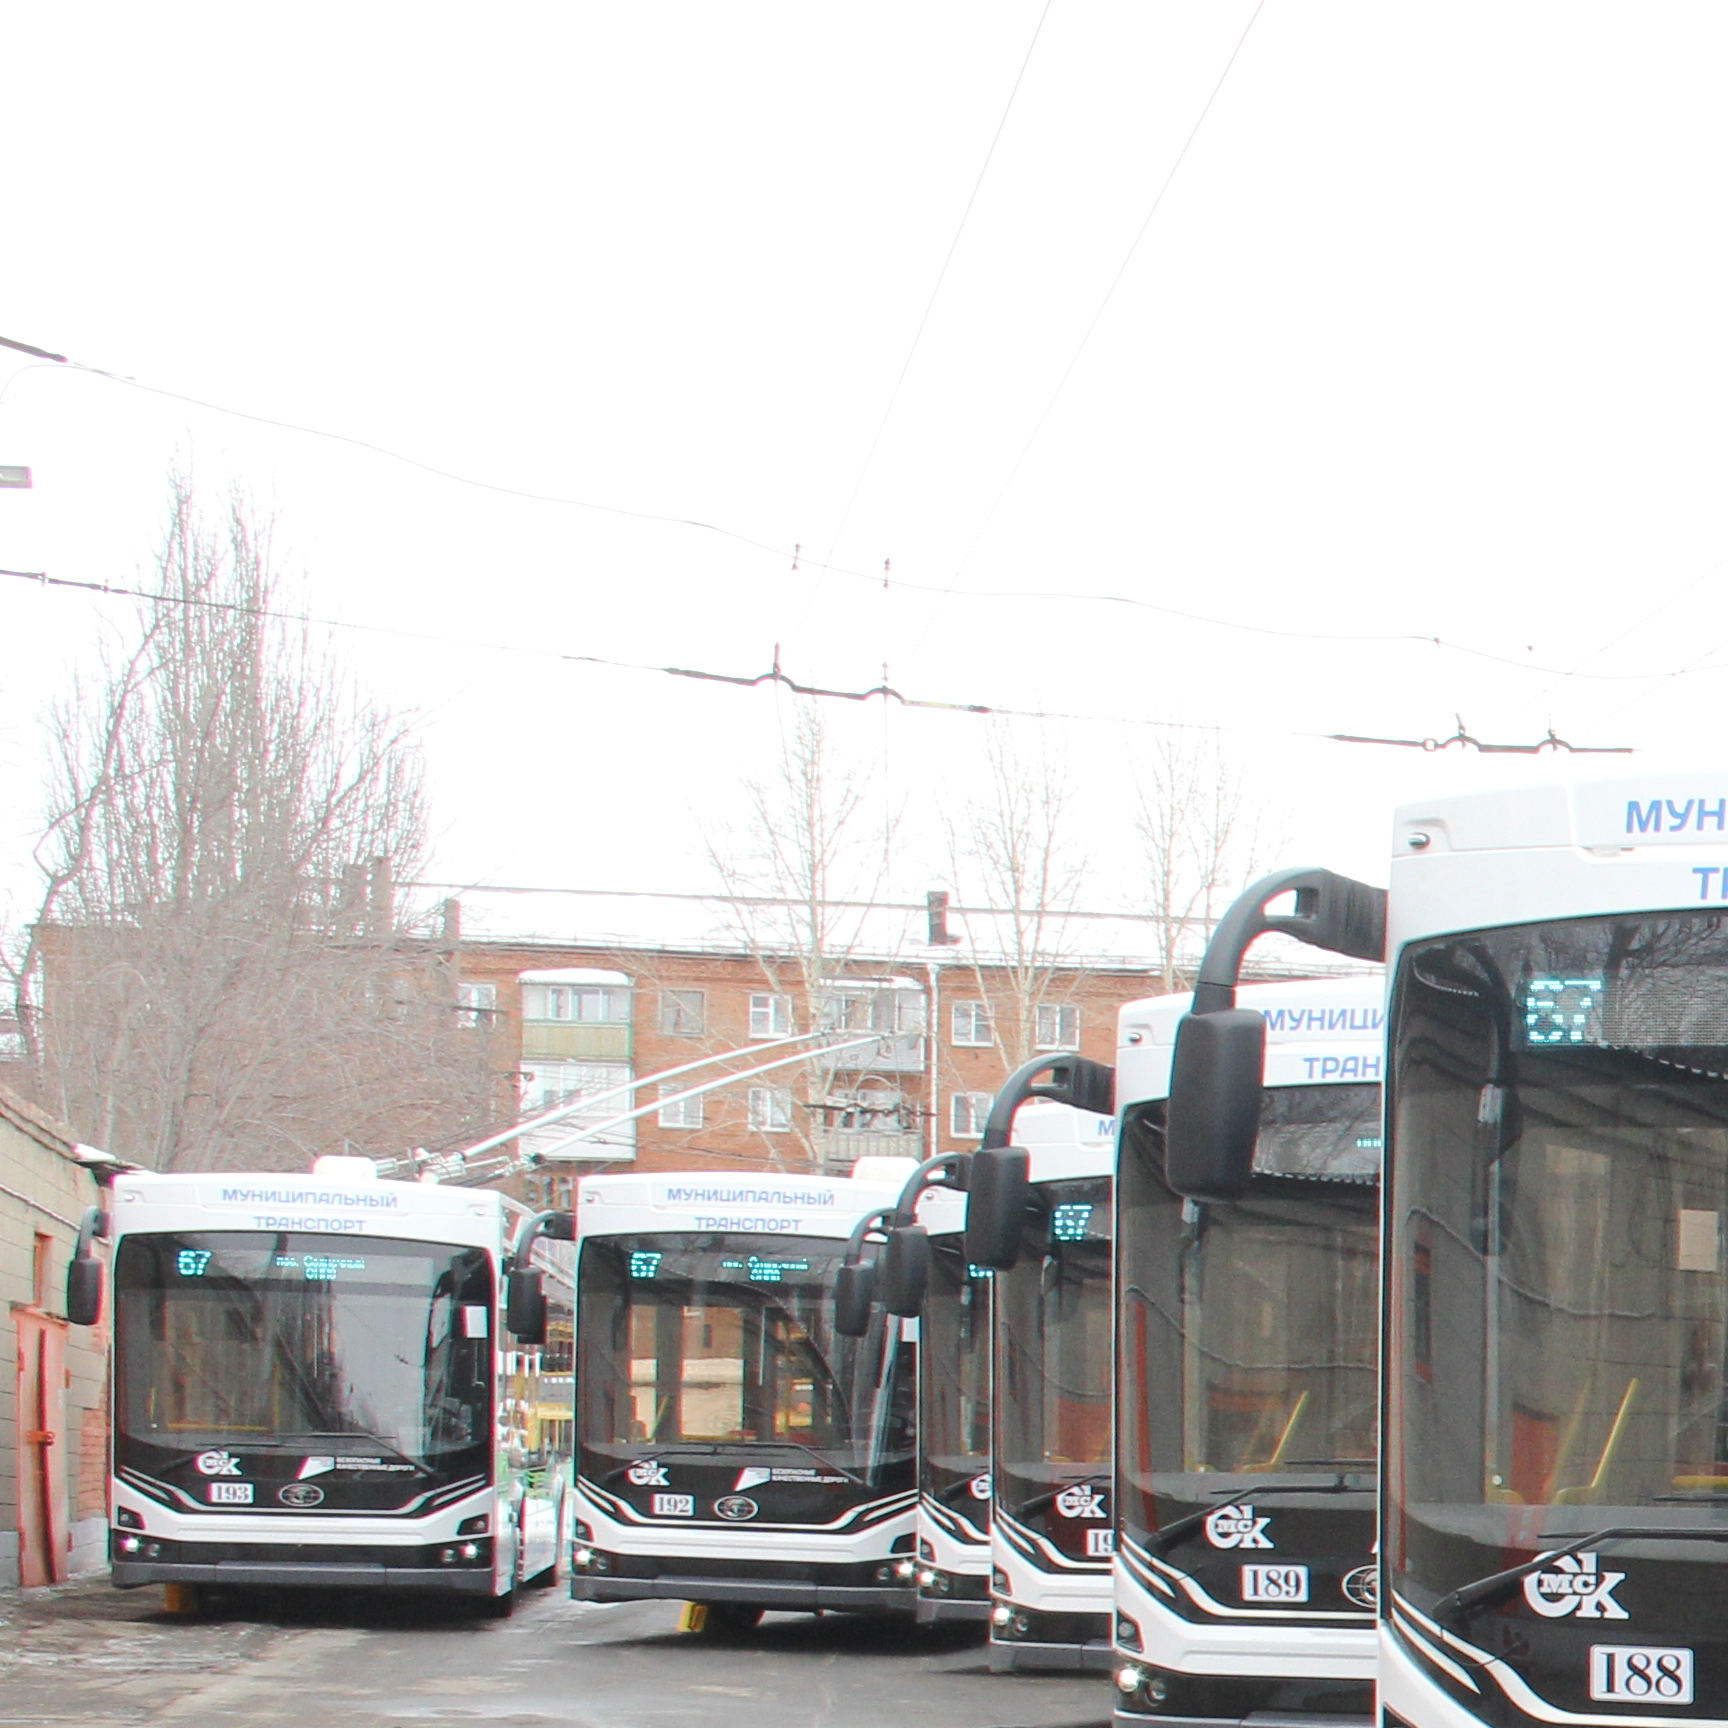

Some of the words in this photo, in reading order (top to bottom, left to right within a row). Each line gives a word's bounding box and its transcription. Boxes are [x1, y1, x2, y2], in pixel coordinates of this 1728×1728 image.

[1526, 980, 1601, 1042] 67
[221, 1187, 399, 1208] МУНИЦИПАЛЬНЫЙ
[667, 1188, 835, 1206] МУНИЦИПАЛЬНЫЙ
[253, 1216, 367, 1232] ТРАНСПОРТ
[694, 1217, 803, 1232] ТРАНСПОРТ
[176, 1249, 213, 1276] 67
[214, 1484, 250, 1502] 193
[656, 1495, 691, 1513] 192
[1250, 1569, 1303, 1598] 189
[1600, 1652, 1683, 1697] 188
